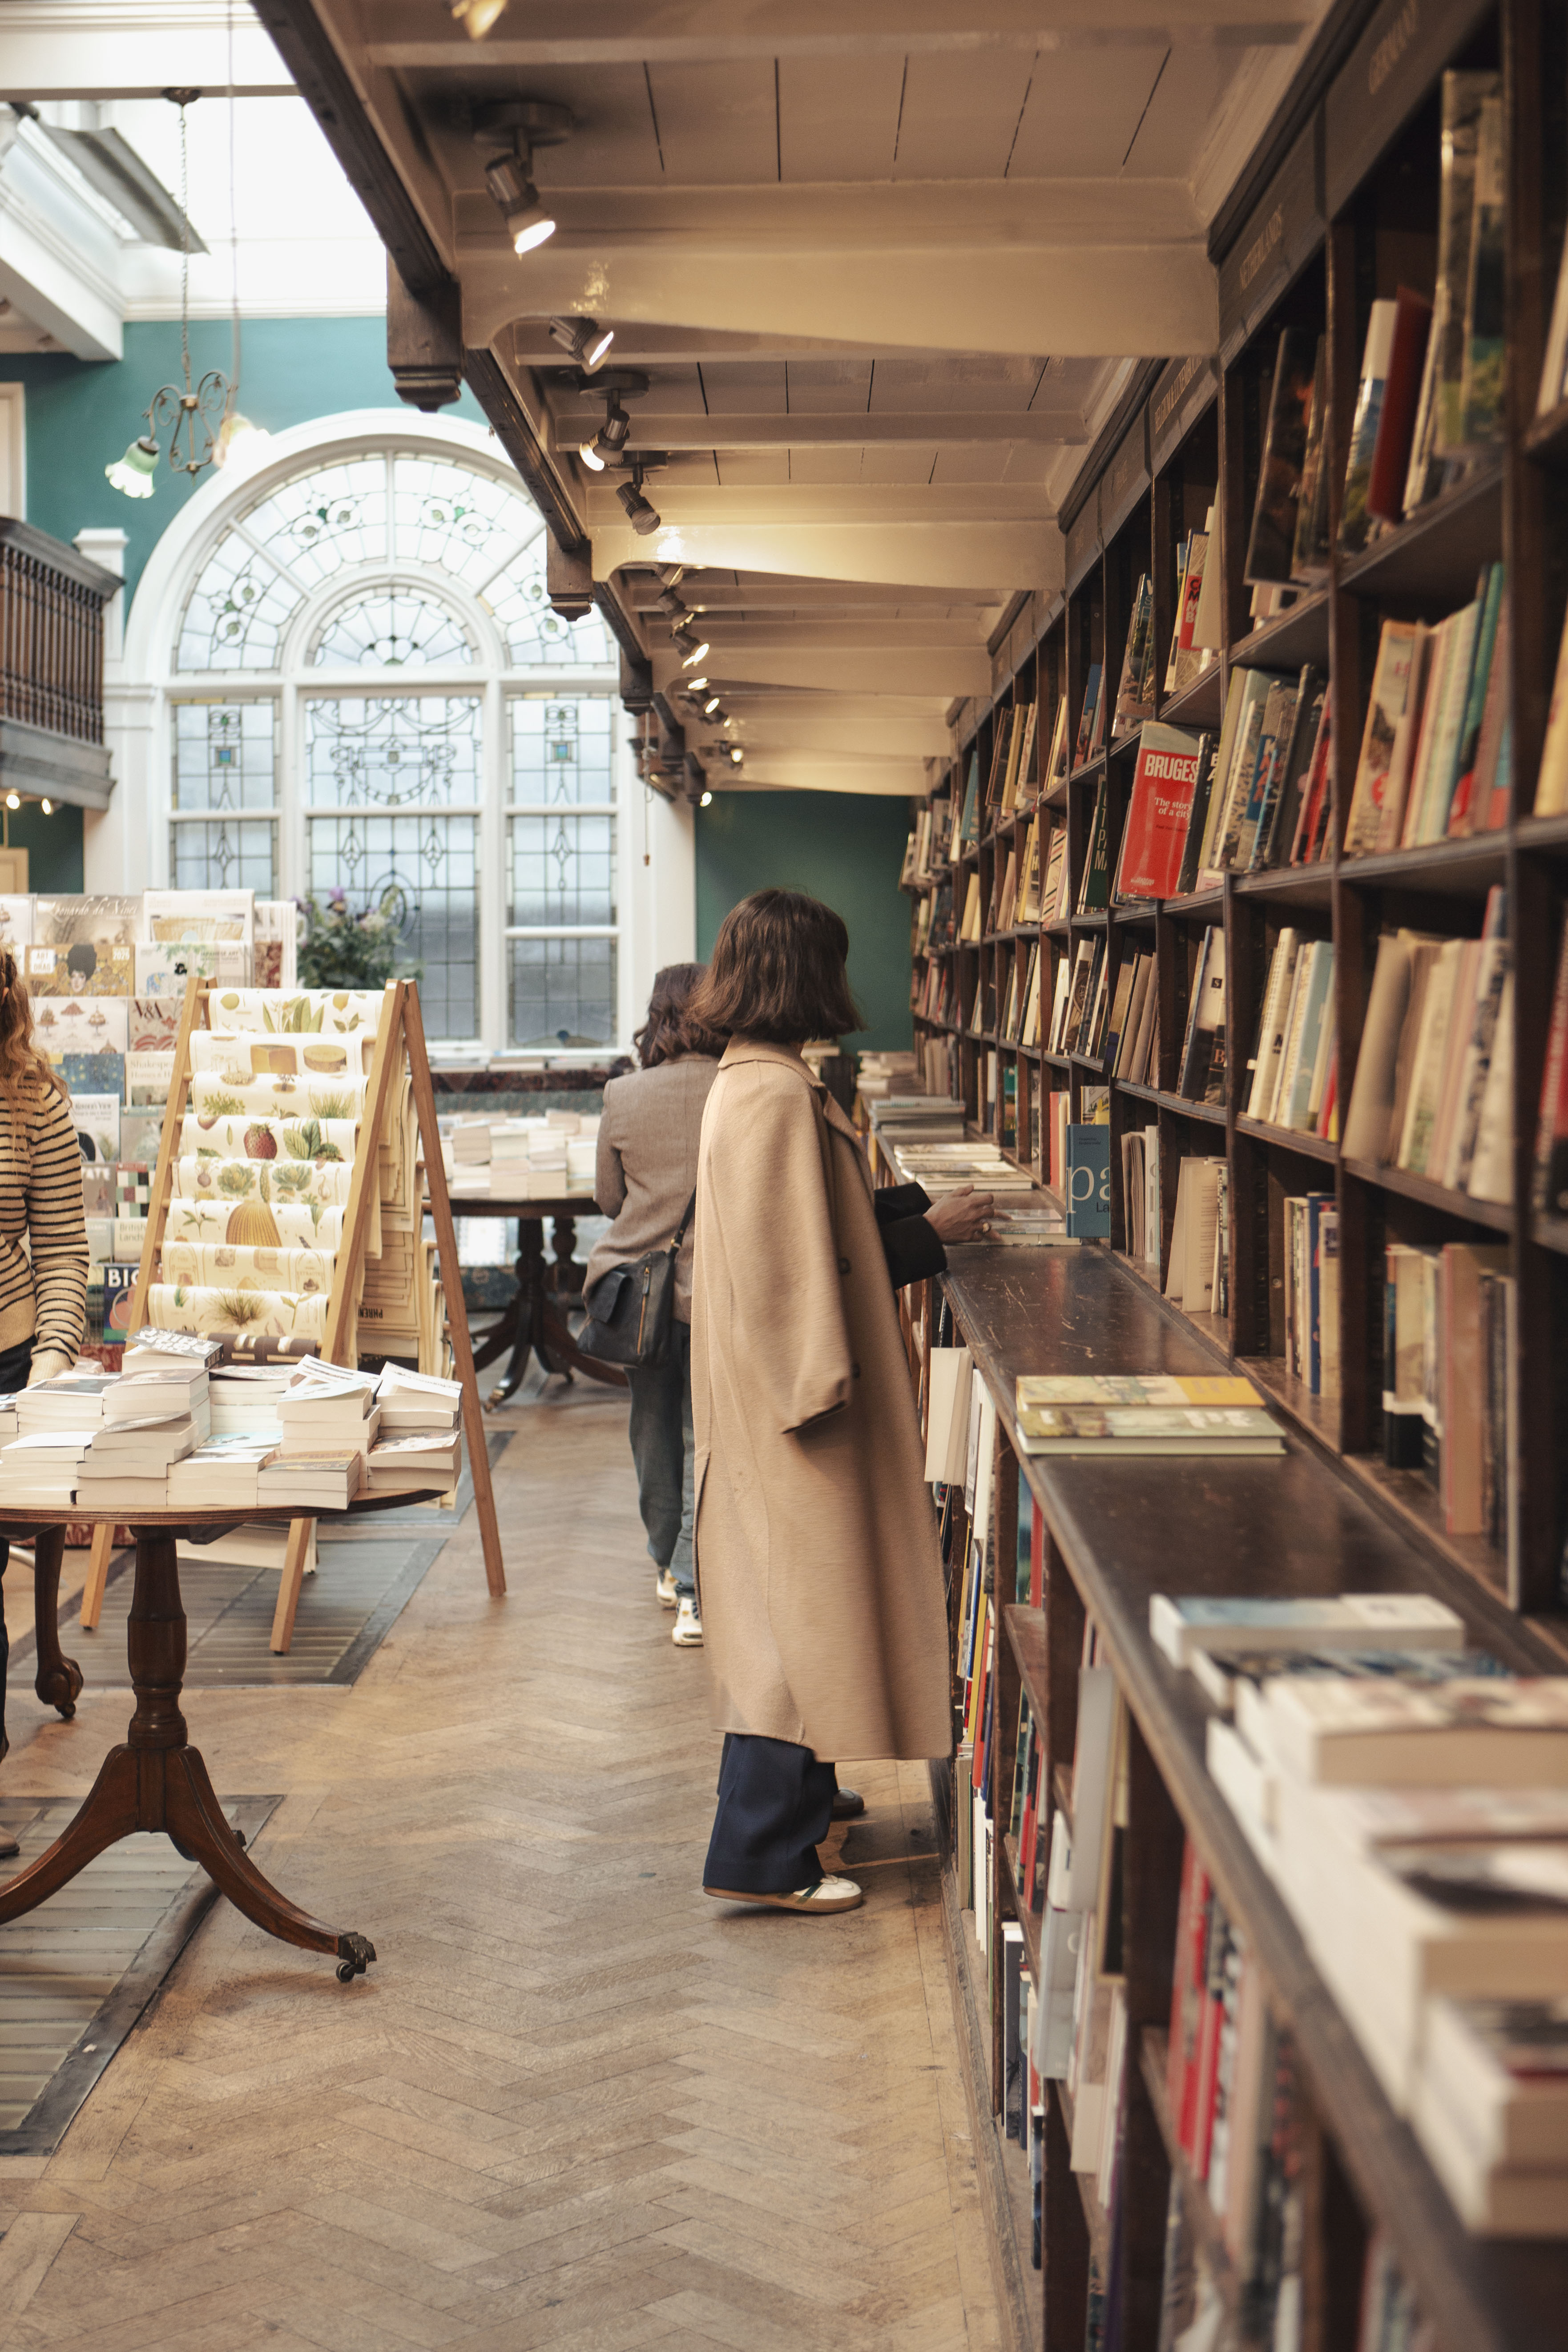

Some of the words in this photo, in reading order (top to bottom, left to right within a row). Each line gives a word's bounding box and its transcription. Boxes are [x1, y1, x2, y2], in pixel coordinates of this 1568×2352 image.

[1144, 754, 1199, 783] BRUGES
[1154, 797, 1170, 807] The
[1172, 801, 1193, 811] story
[1158, 807, 1169, 815] of
[1176, 810, 1192, 820] city
[133, 999, 163, 1019] V&A
[358, 1307, 383, 1319] PHREN
